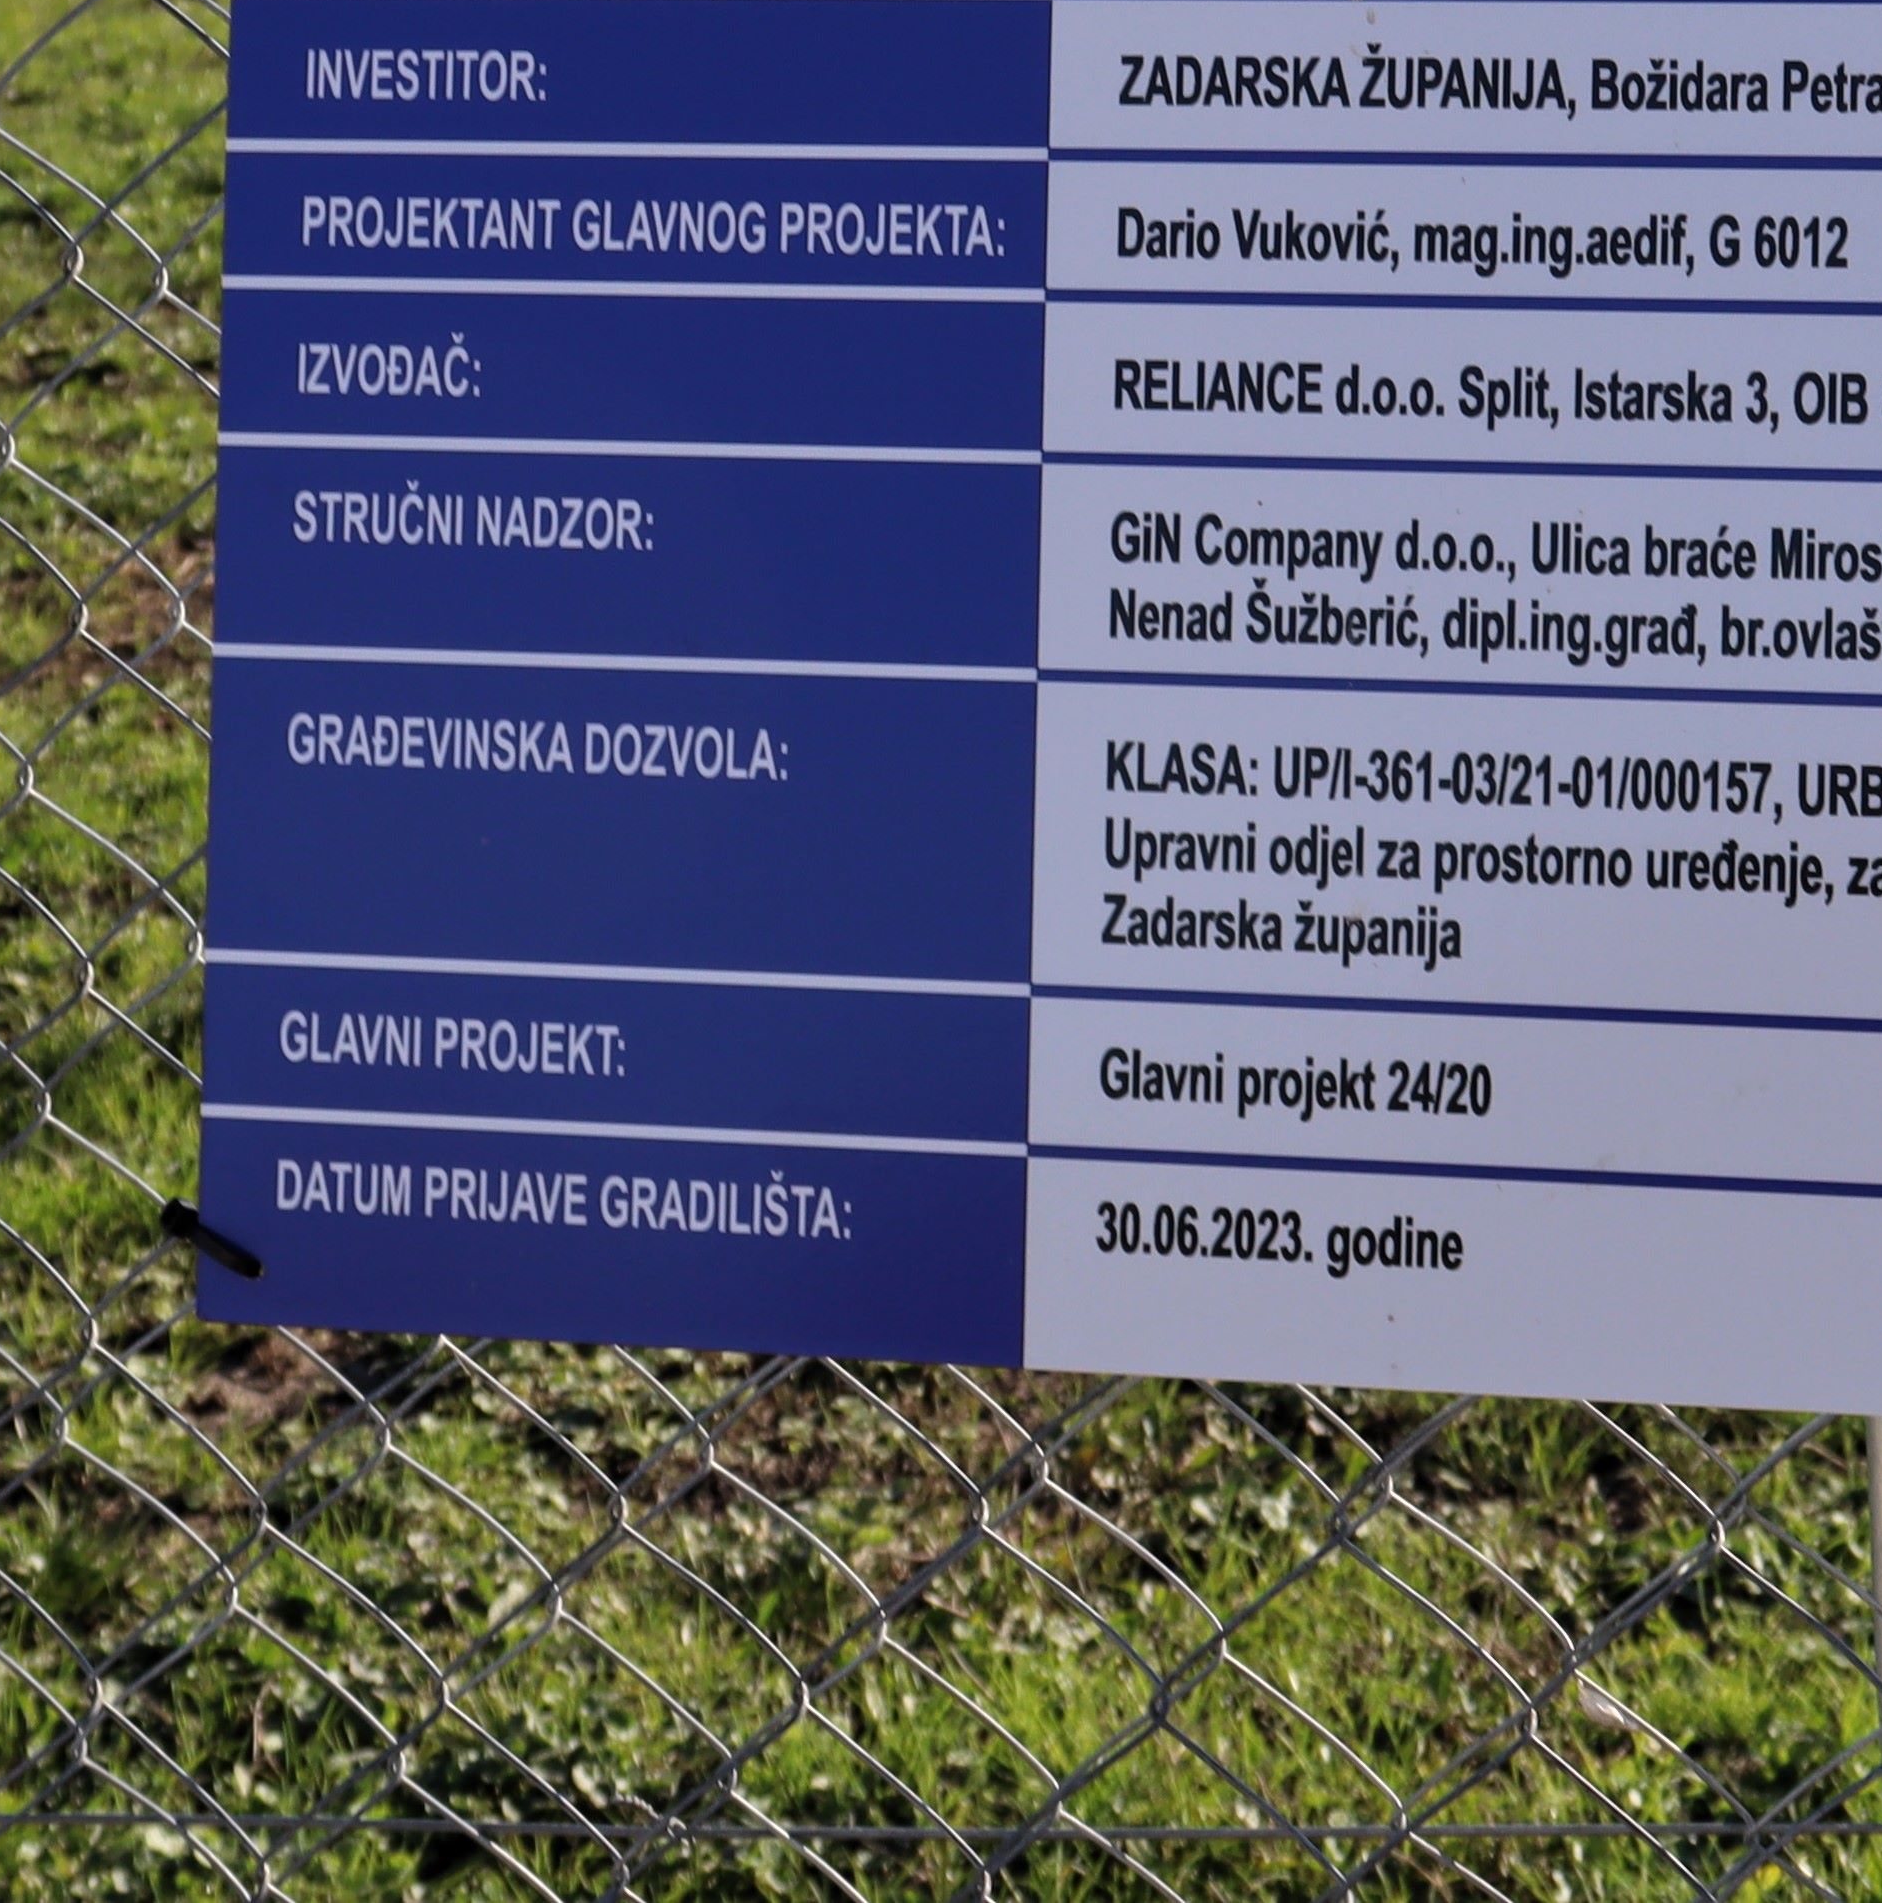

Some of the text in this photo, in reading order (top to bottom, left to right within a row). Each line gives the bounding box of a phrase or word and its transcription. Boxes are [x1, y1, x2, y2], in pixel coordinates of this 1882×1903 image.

[306, 48, 547, 102] INVESTITOR:
[1119, 55, 1351, 108] ZADARSKA
[1359, 43, 1576, 121] ŽUPANIJA,
[1591, 58, 1768, 113] Božidara
[302, 195, 1005, 257] PROJEKTANT GLAVNOG PROJEKTA:
[1117, 207, 1848, 279] Dario Vuković, mag.ing.aedif, G 6012
[298, 331, 481, 398] IZVOĐAČ:
[1114, 359, 1323, 414] RELIANCE
[1335, 363, 1445, 417] d.o.o.
[1458, 365, 1559, 432] Split,
[1574, 368, 1732, 423] Istarska
[1746, 371, 1779, 434] 3,
[1793, 371, 1868, 425] OIB
[293, 479, 654, 551] STRUČNI NADZOR:
[1111, 511, 1181, 563] GiN
[1195, 513, 1383, 584] Company
[1395, 519, 1516, 583] d.o.o.,
[1532, 521, 1630, 576] Ulica
[1644, 524, 1757, 579] braće
[1109, 588, 1233, 642] Nenad
[1246, 577, 1428, 658] Šužberić,
[1442, 597, 1706, 668] dipl.ing.građ,
[287, 712, 789, 781] GRAĐEVINSKA DOZVOLA:
[1106, 740, 1258, 796] KLASA:
[1274, 746, 1782, 825] UP/I-361-03/21-01/000157,
[1105, 817, 1256, 882] Upravni
[1269, 824, 1364, 890] odjel
[1376, 840, 1421, 880] za
[1434, 834, 1632, 894] prostorno
[1646, 839, 1834, 908] uređenje,
[1101, 893, 1461, 972] Zadarska županija
[279, 1009, 626, 1077] GLAVNI PROJEKT:
[1100, 1047, 1492, 1122] Glavni projekt 24/20
[276, 1158, 852, 1240] DATUM PRIJAVE GRADILIŠTA:
[1096, 1201, 1463, 1279] 30.06.2023. godine
